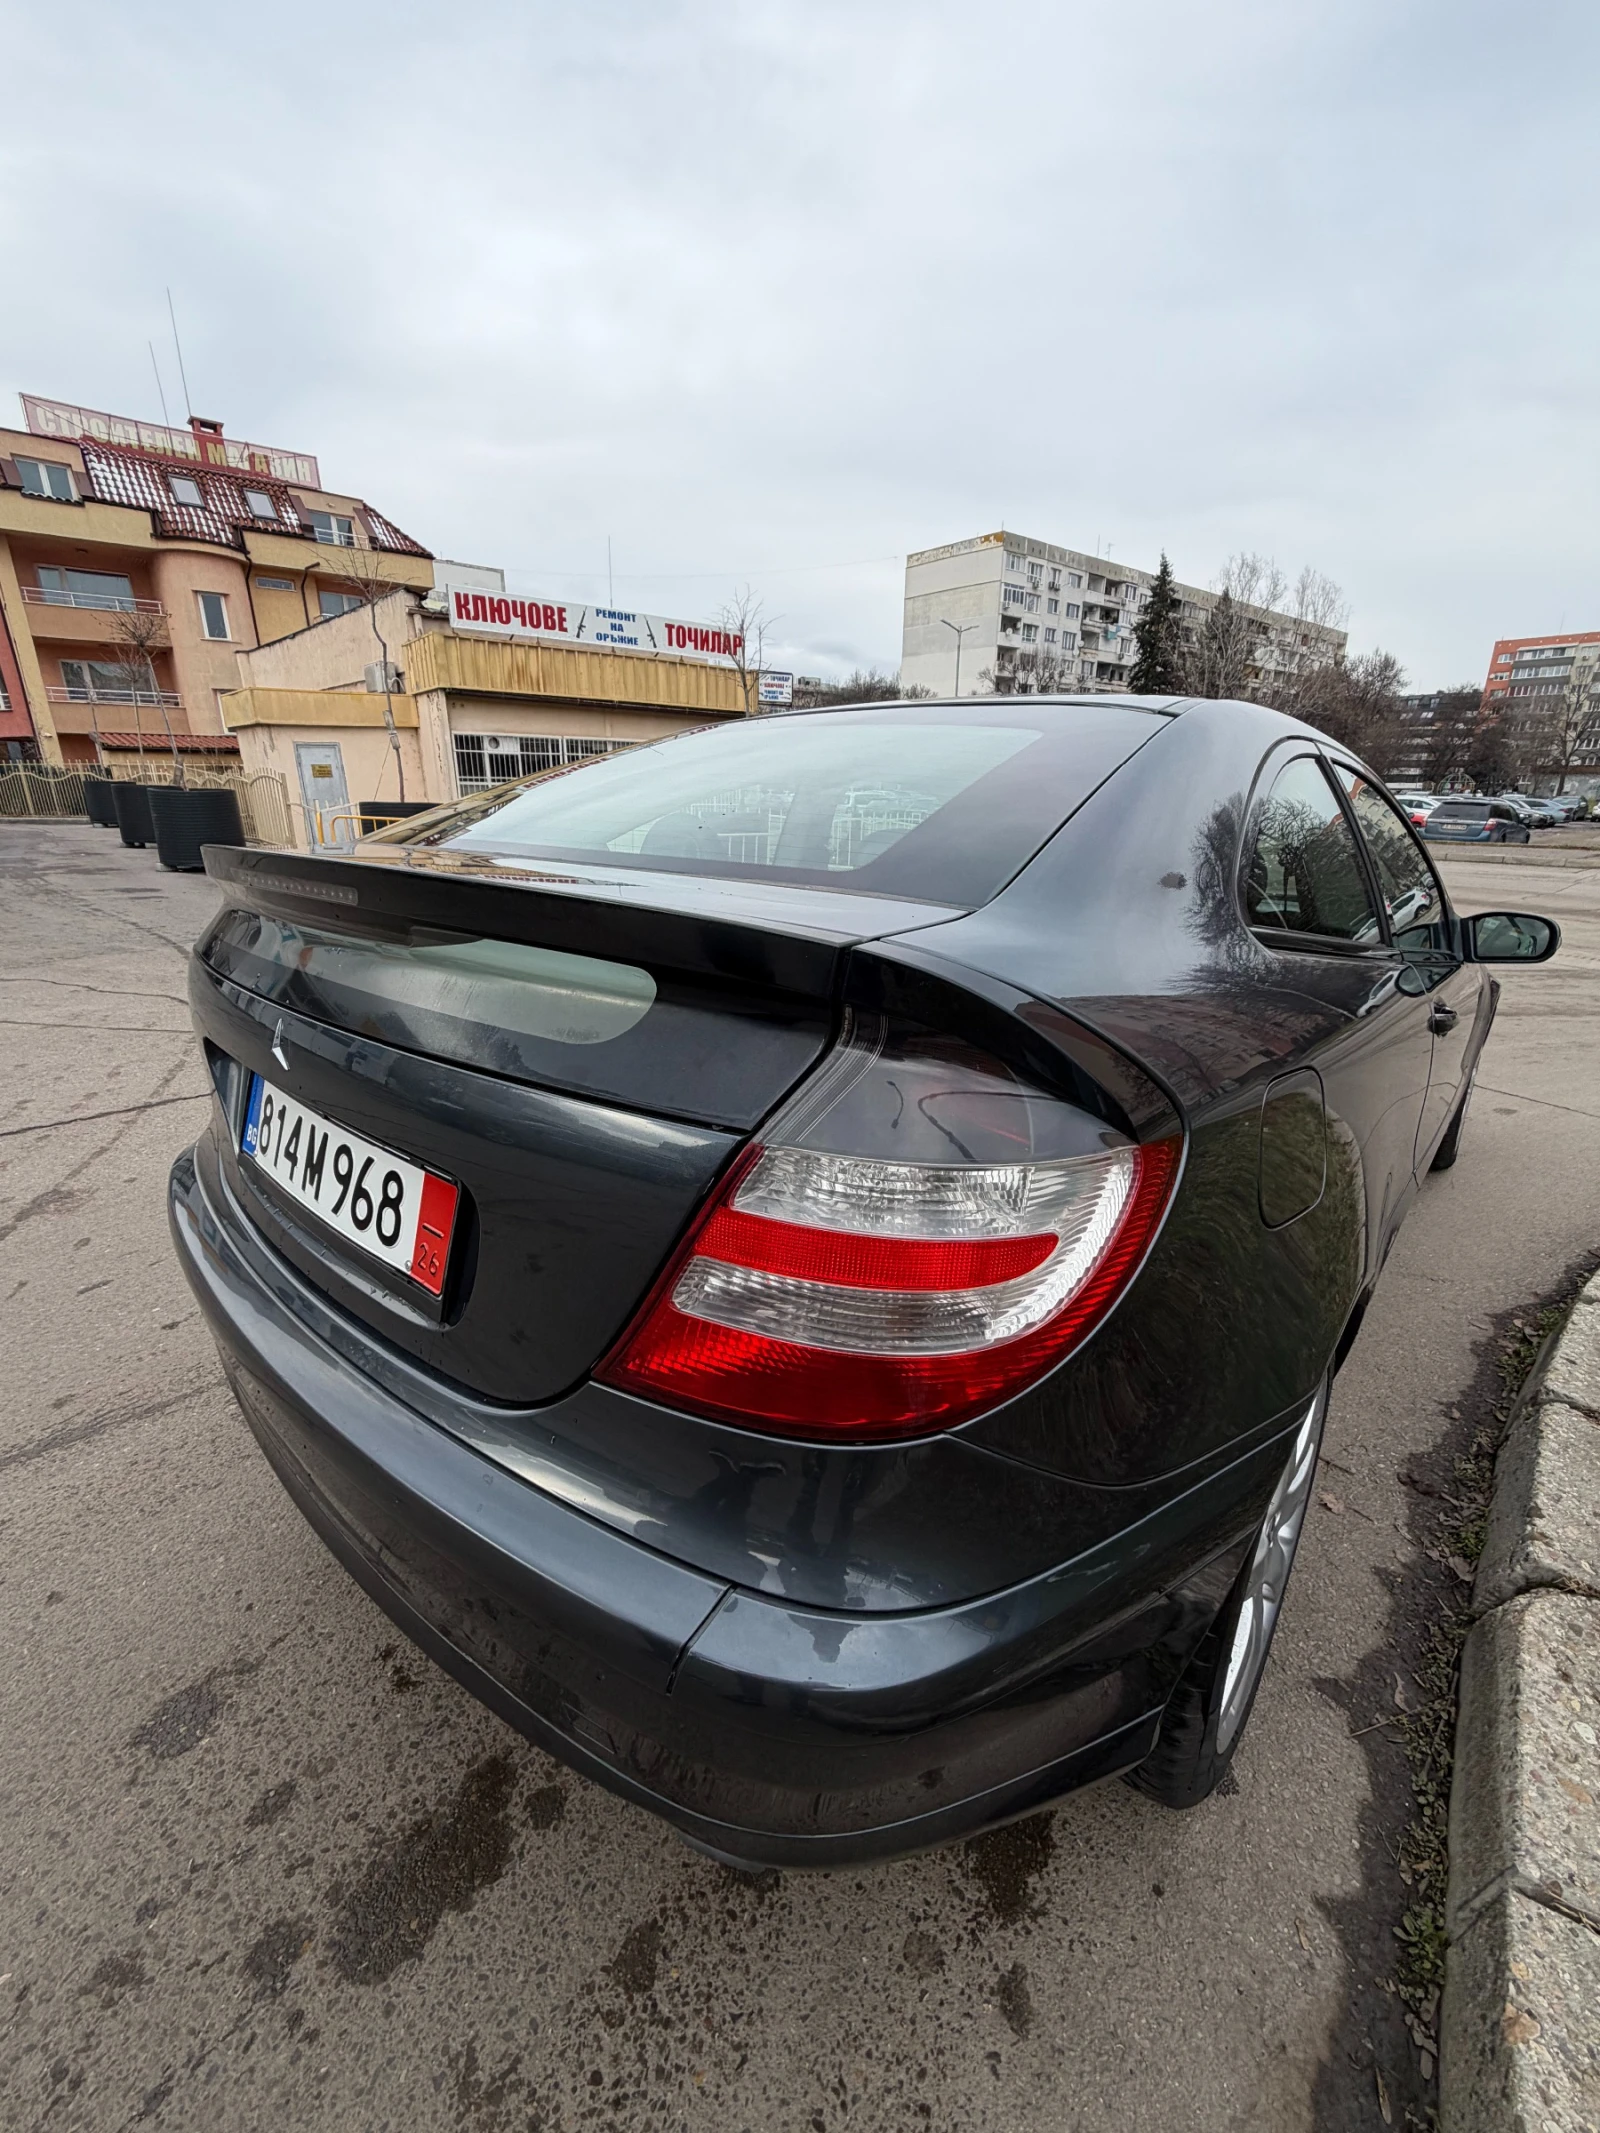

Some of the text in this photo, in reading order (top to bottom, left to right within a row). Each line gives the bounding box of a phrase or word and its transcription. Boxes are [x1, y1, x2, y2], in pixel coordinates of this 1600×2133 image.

[36, 406, 202, 462] СТРОИТЕЛЕН
[454, 591, 568, 633] КЛЮЧОВЕ
[595, 608, 637, 623] РЕМОНТ
[610, 622, 624, 633] НА
[596, 632, 639, 646] ОРЪЖИЕ
[664, 622, 743, 656] ТОЧИЛАР
[246, 1122, 257, 1146] BG
[259, 1094, 404, 1247] 814M968
[417, 1242, 440, 1276] 26
